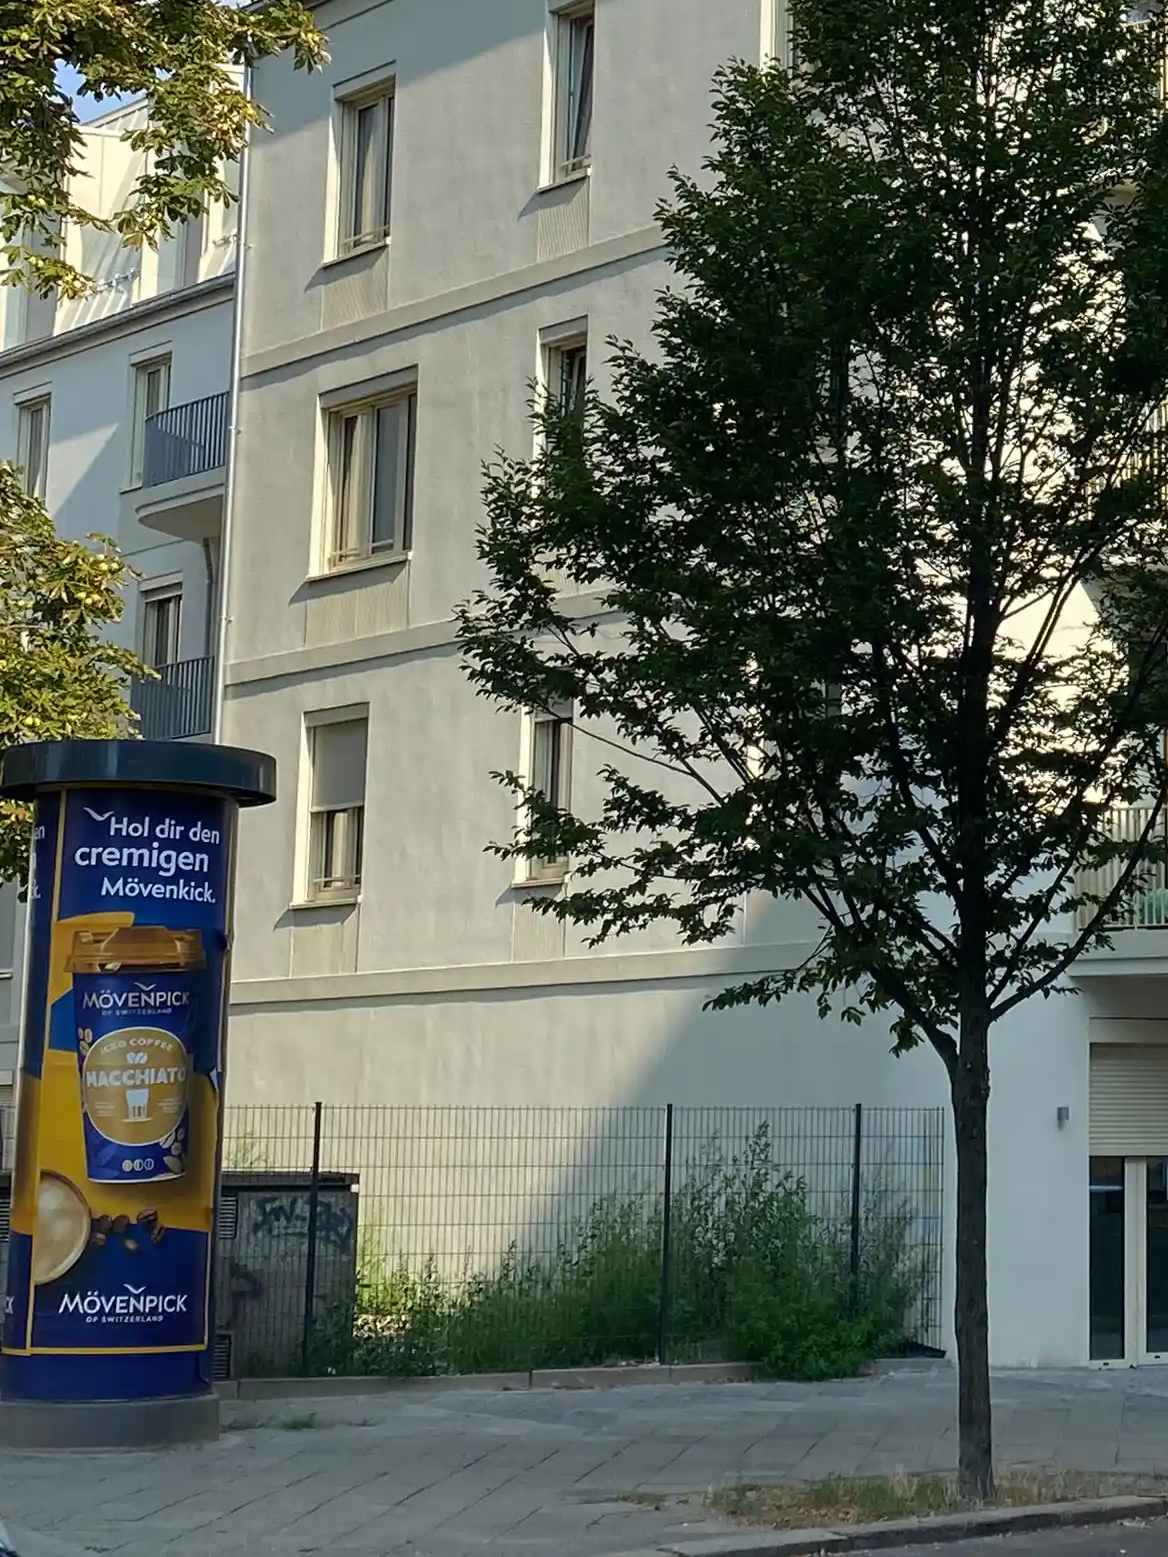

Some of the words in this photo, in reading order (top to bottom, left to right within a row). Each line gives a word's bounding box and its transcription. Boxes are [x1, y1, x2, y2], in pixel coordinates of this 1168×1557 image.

[109, 816, 149, 838] Hol
[155, 817, 185, 840] dir
[189, 821, 220, 845] den
[74, 841, 209, 877] cremigen
[100, 876, 216, 904] Mövenkick.
[82, 989, 190, 1010] MÖVENPICK
[58, 1290, 188, 1314] MÖVENPICK
[101, 1314, 164, 1323] SWITZERLAND
